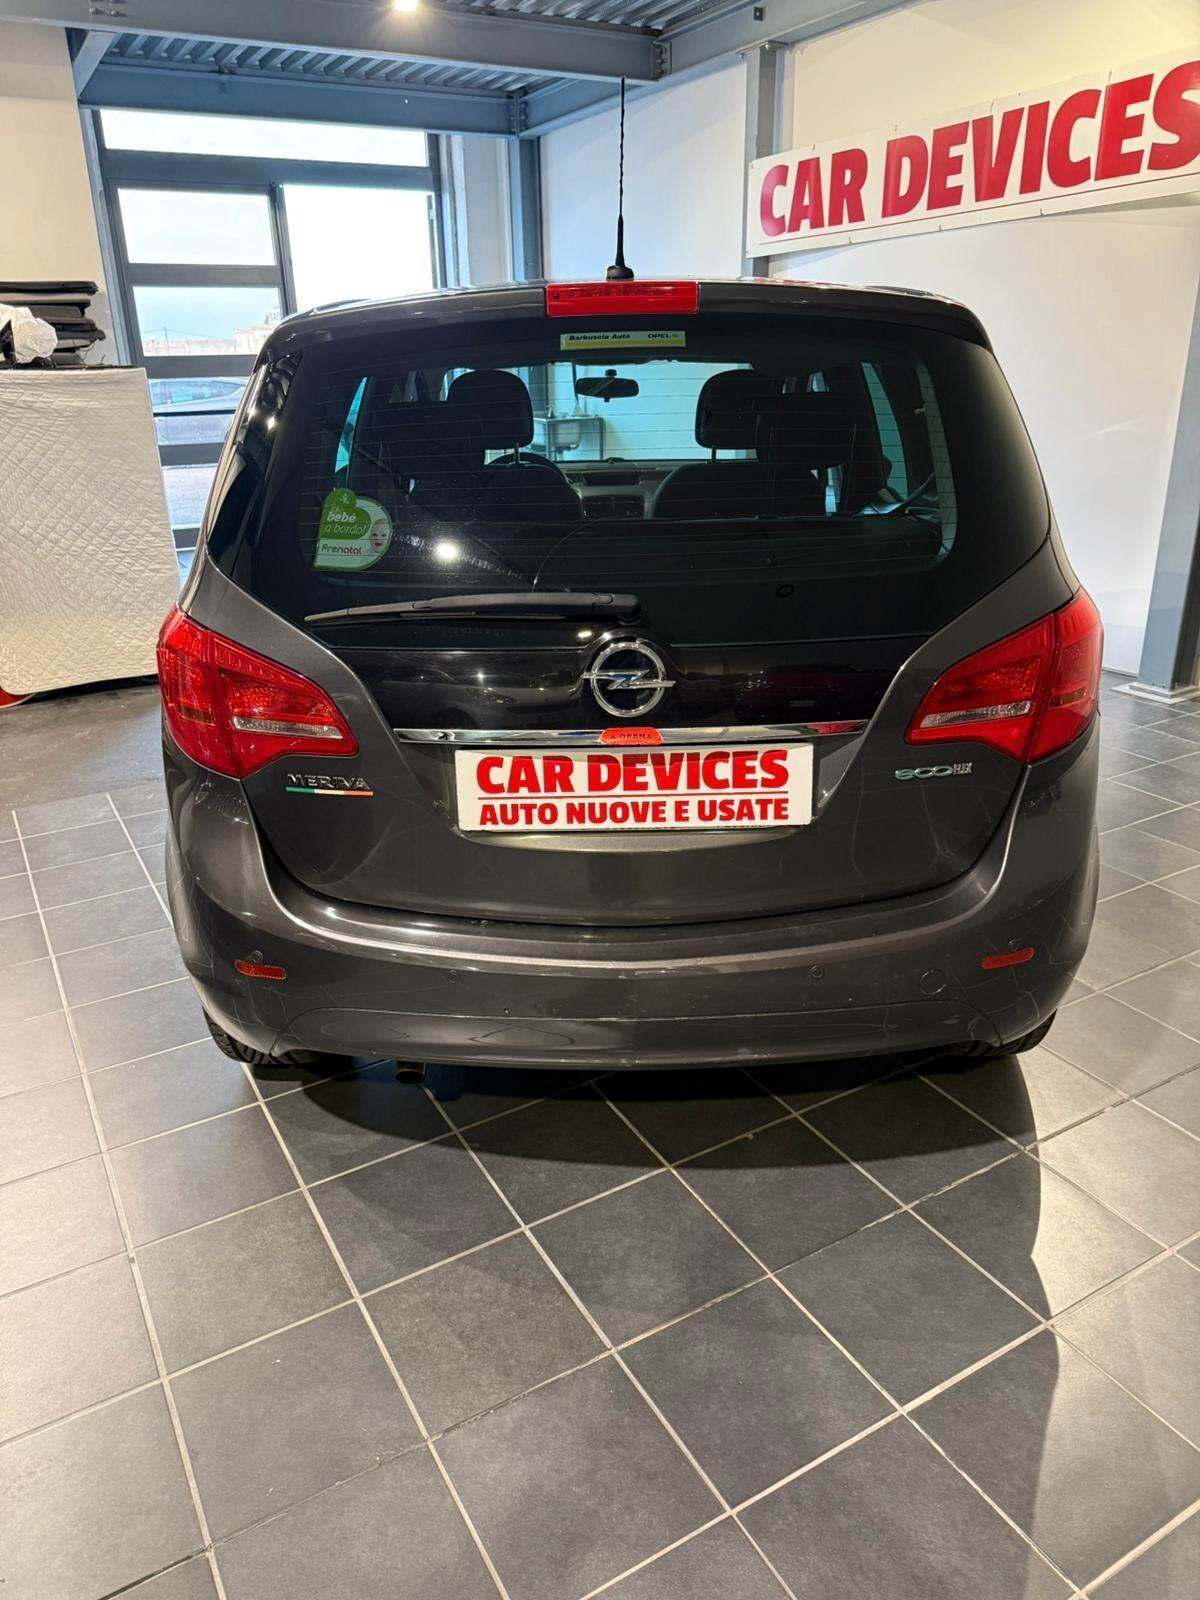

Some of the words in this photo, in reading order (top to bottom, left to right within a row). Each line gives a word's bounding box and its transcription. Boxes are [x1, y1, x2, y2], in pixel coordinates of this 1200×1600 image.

[759, 147, 869, 237] CAR
[881, 59, 1200, 218] DEVICES
[568, 333, 610, 341] Barbuscia
[325, 525, 331, 533] a
[334, 523, 366, 534] bordo!
[287, 773, 371, 789] MERIVA
[476, 754, 575, 794] CAR
[588, 750, 789, 791] DEVICES
[478, 802, 558, 825] AUTO
[566, 800, 666, 824] NUOVE
[674, 799, 689, 822] E
[697, 797, 789, 822] USATE
